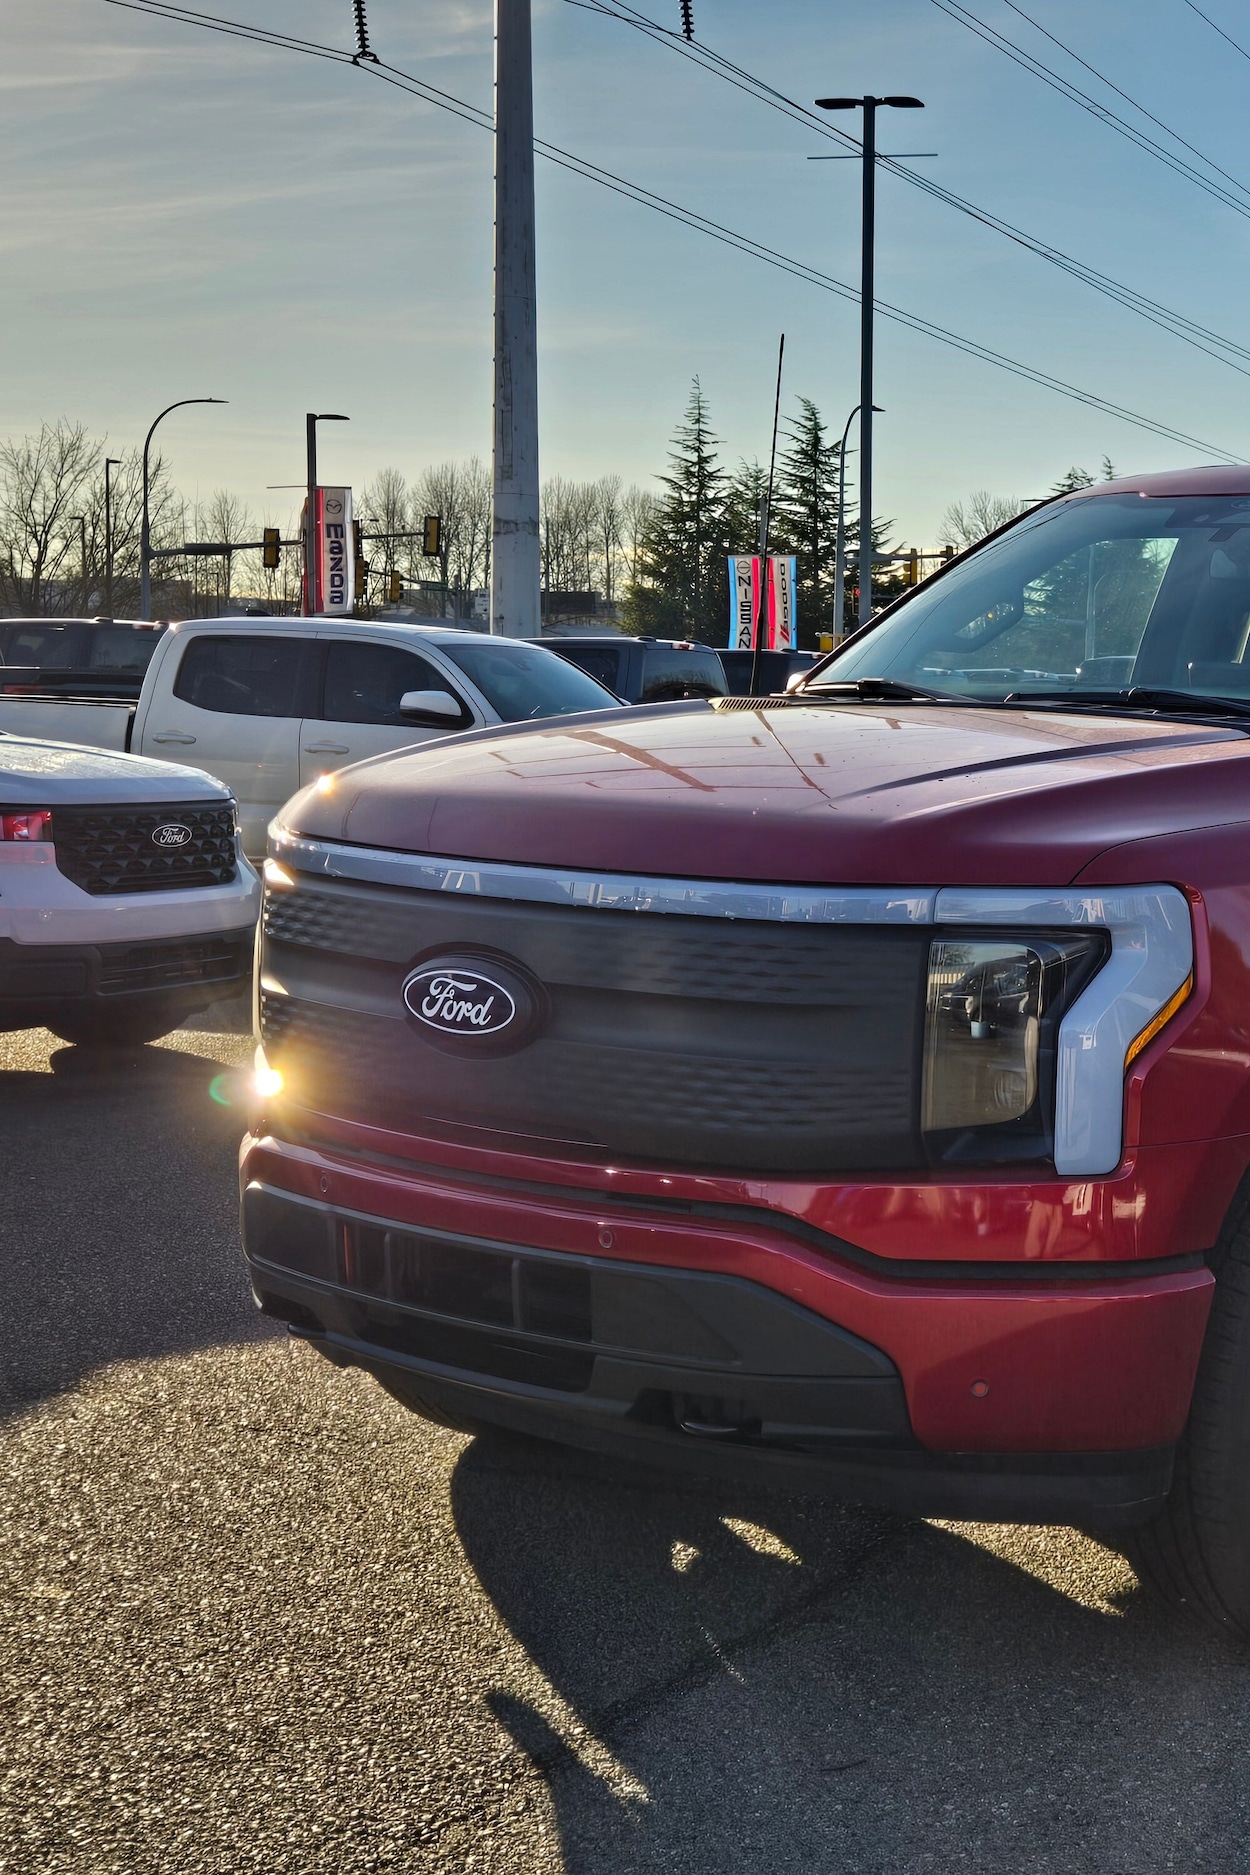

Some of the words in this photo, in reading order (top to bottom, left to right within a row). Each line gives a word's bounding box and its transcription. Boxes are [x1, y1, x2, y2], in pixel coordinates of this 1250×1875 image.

[738, 575, 752, 649] NISSAN
[780, 563, 789, 630] DODGE
[160, 827, 185, 843] Ford
[421, 977, 494, 1026] Ford
